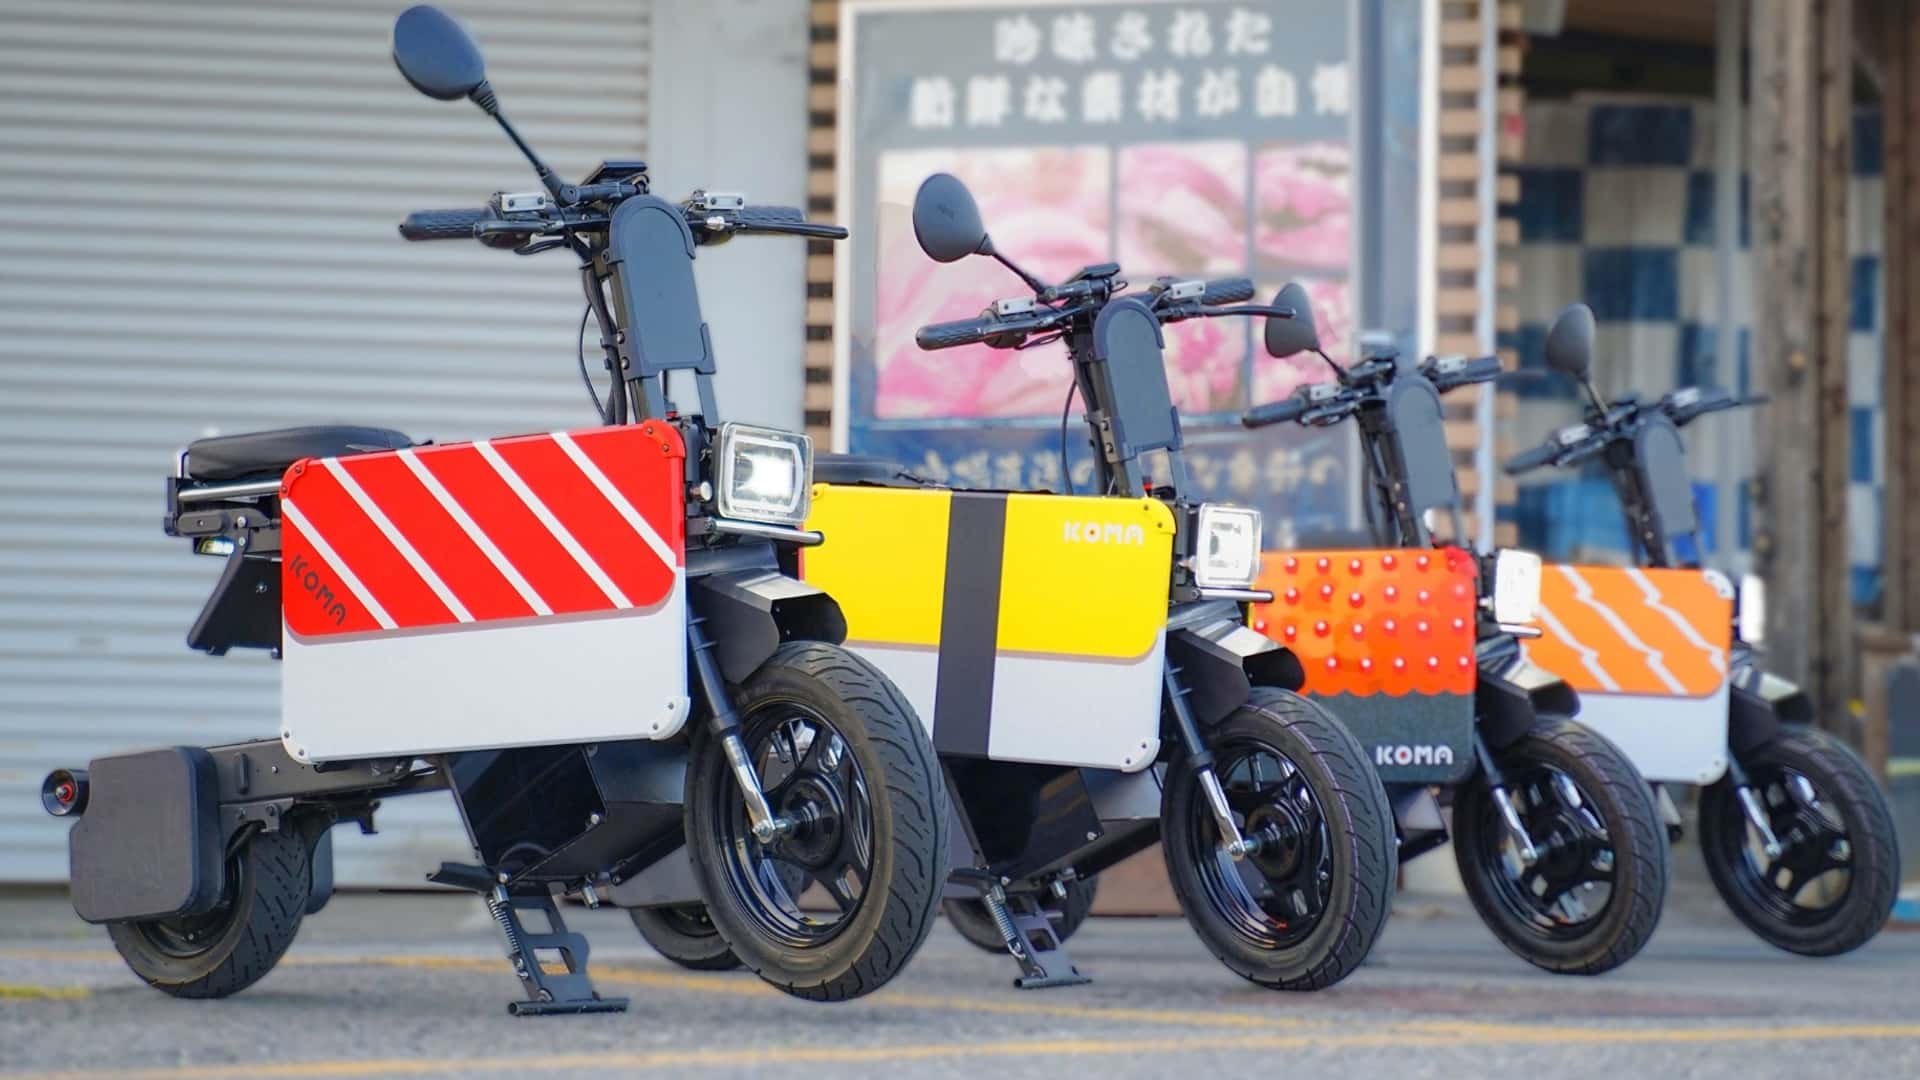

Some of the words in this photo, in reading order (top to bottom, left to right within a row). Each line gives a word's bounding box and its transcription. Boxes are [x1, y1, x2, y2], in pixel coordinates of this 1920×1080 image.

[1063, 520, 1144, 545] KOMA
[289, 553, 347, 626] KOMA
[1375, 745, 1454, 766] KOMA
